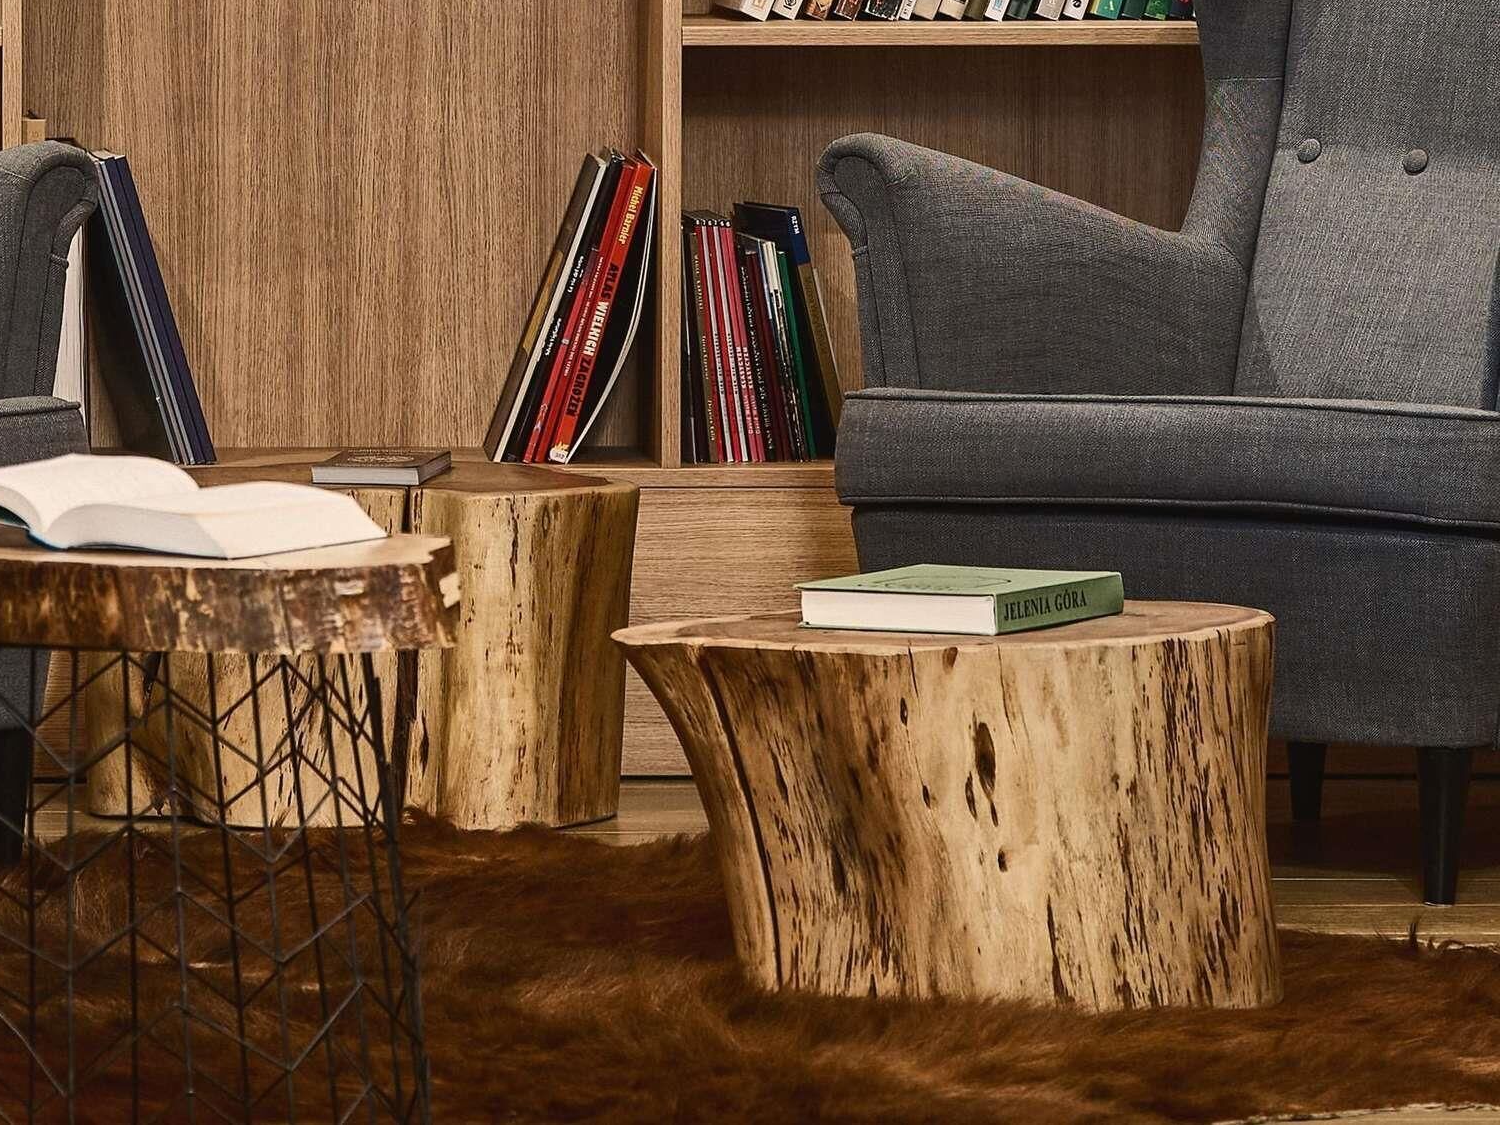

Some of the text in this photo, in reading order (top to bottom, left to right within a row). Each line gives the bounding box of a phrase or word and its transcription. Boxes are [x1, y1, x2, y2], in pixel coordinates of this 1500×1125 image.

[616, 185, 644, 245] Michel Barnier
[600, 262, 620, 299] ATLAS
[582, 299, 609, 356] WIELKICH
[1001, 586, 1087, 622] JELENIA GÓRA
